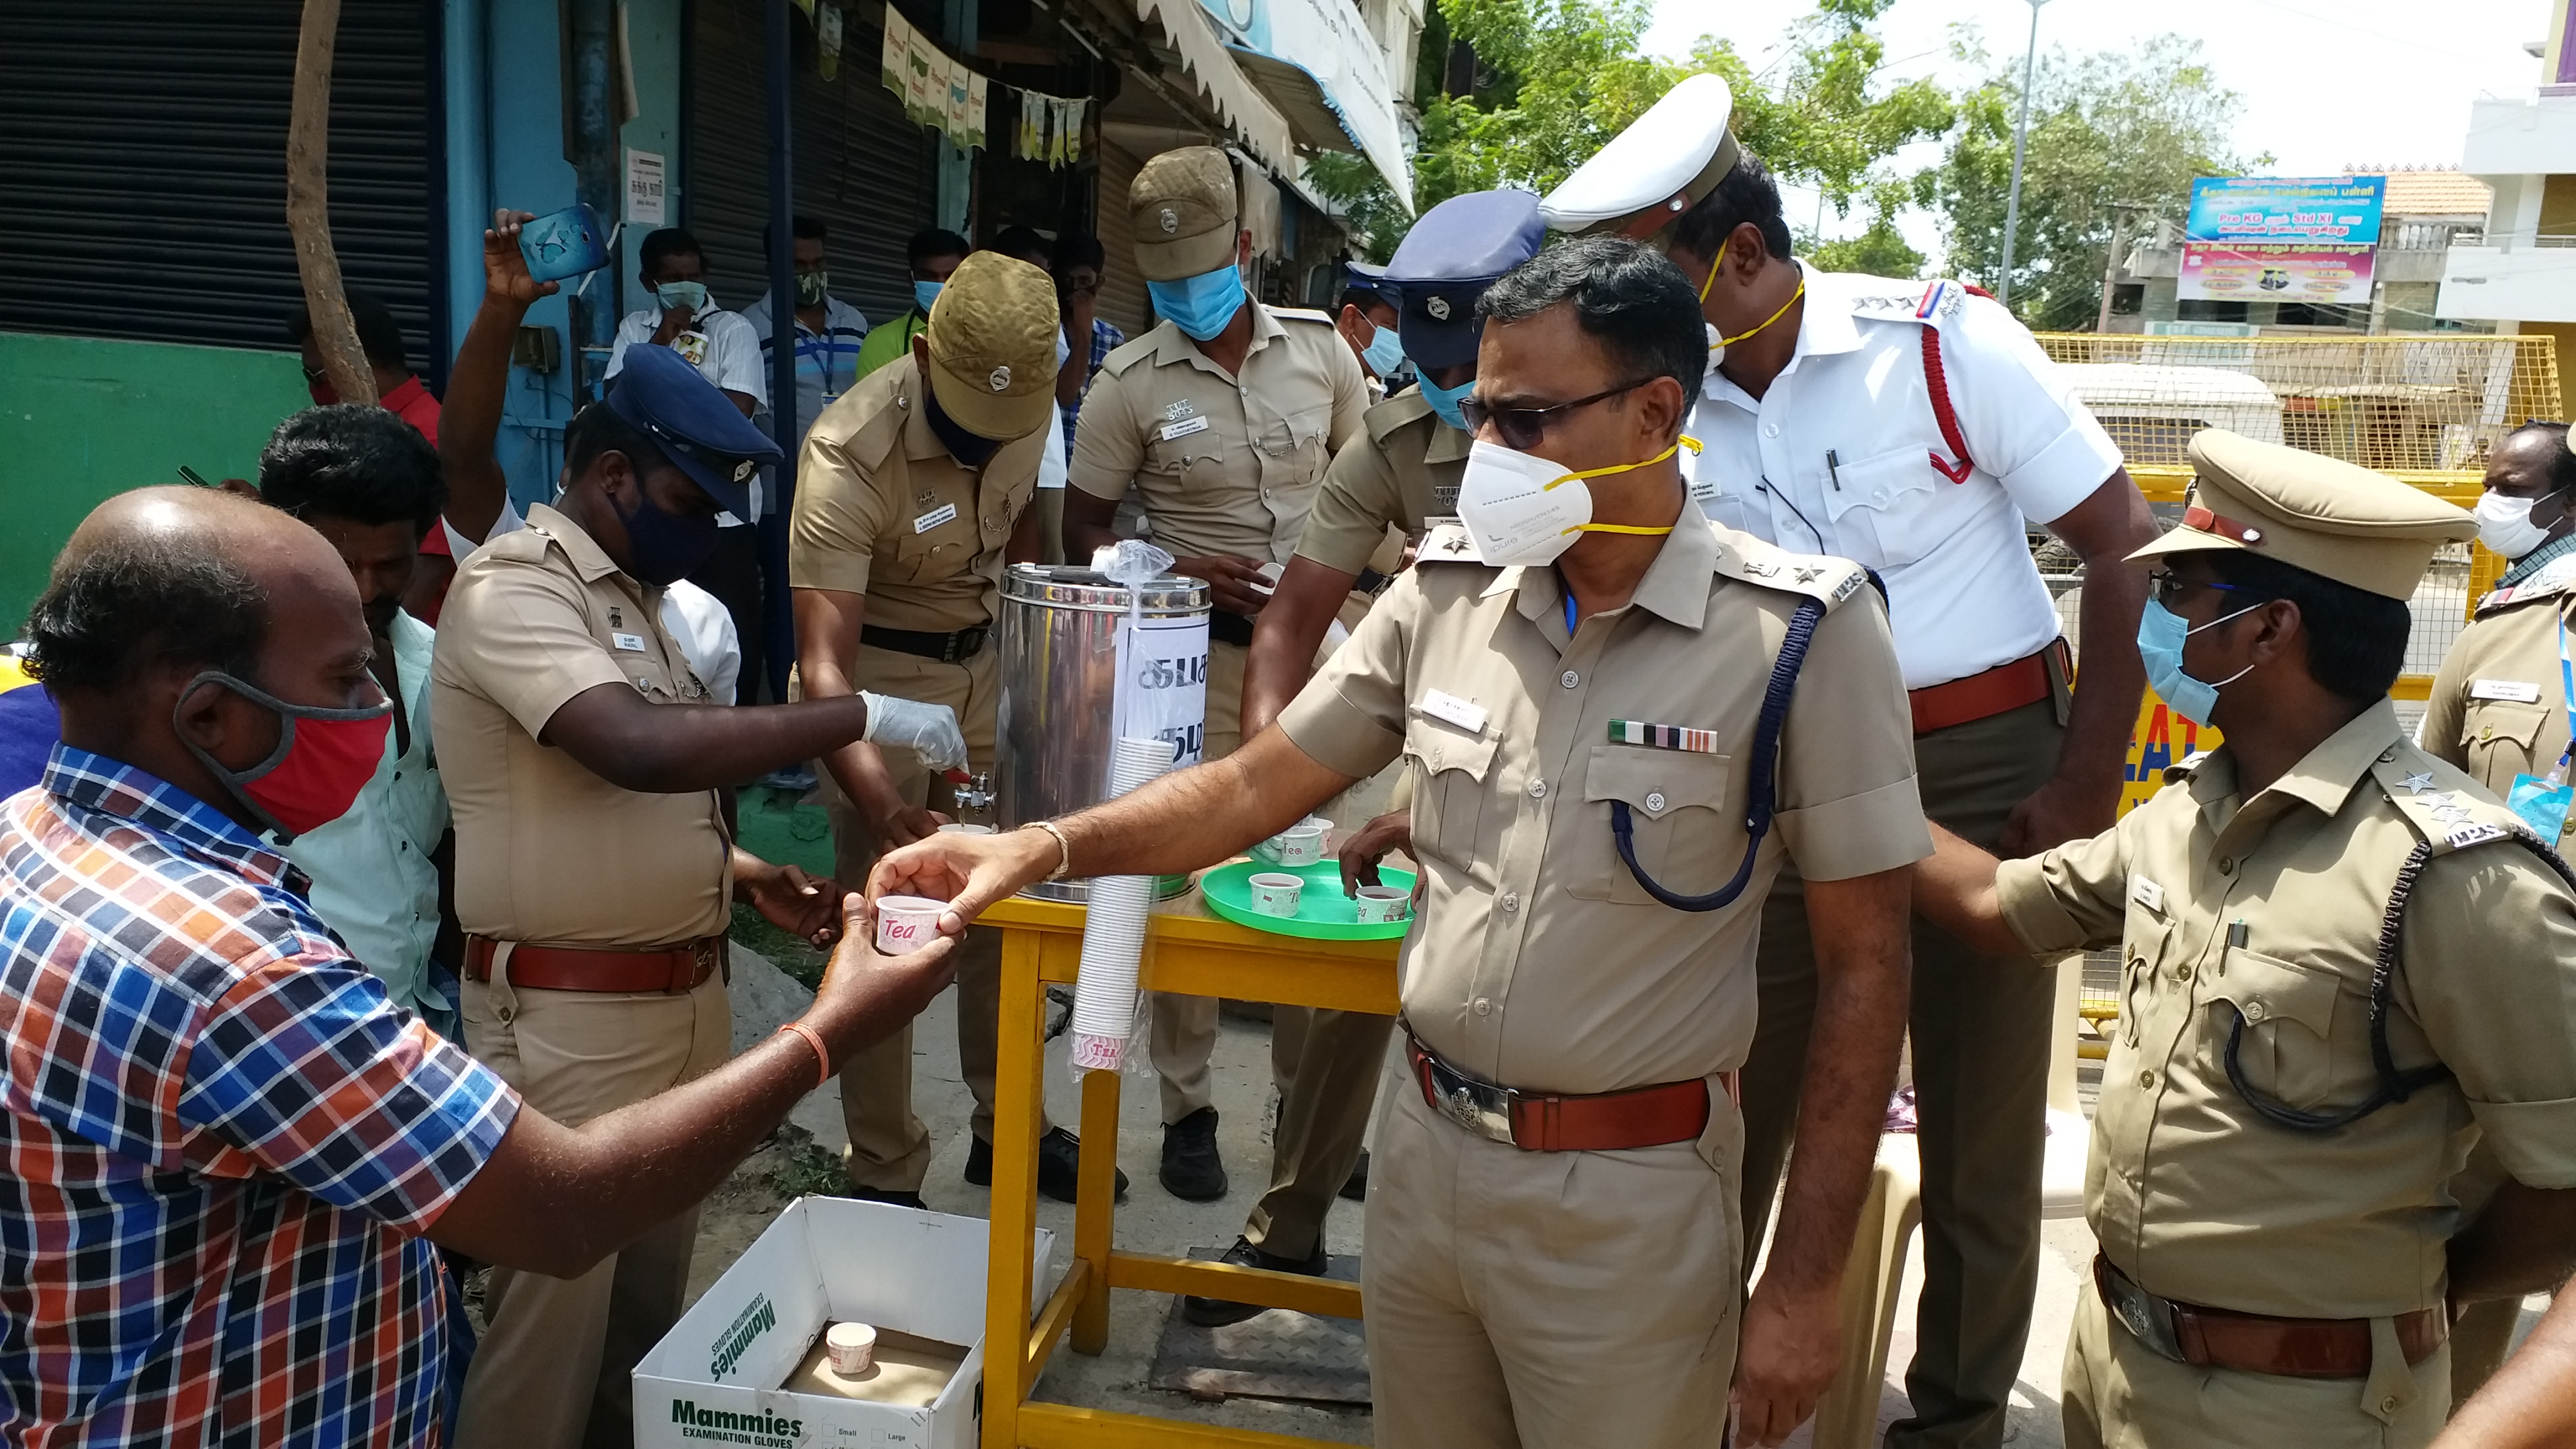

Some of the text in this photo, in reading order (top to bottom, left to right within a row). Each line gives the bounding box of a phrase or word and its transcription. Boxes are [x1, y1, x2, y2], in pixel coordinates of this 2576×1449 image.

[2219, 214, 2240, 222] Pre
[2243, 214, 2261, 222] KG
[2293, 214, 2315, 222] Std
[1166, 399, 1188, 411] TUT
[1510, 505, 1560, 530] NIOSH/EN149
[1490, 537, 1518, 553] ipure
[1284, 842, 1302, 855] Tea
[1357, 902, 1367, 917] ea
[886, 920, 917, 939] Tea
[1092, 1043, 1116, 1058] TEA
[712, 1292, 764, 1356] EXAMINATION GLOVES
[711, 1299, 776, 1382] Mammies
[672, 1399, 803, 1438] Mammies
[683, 1427, 793, 1449] EXAMINATION GLOVES
[888, 1433, 906, 1442] Large
